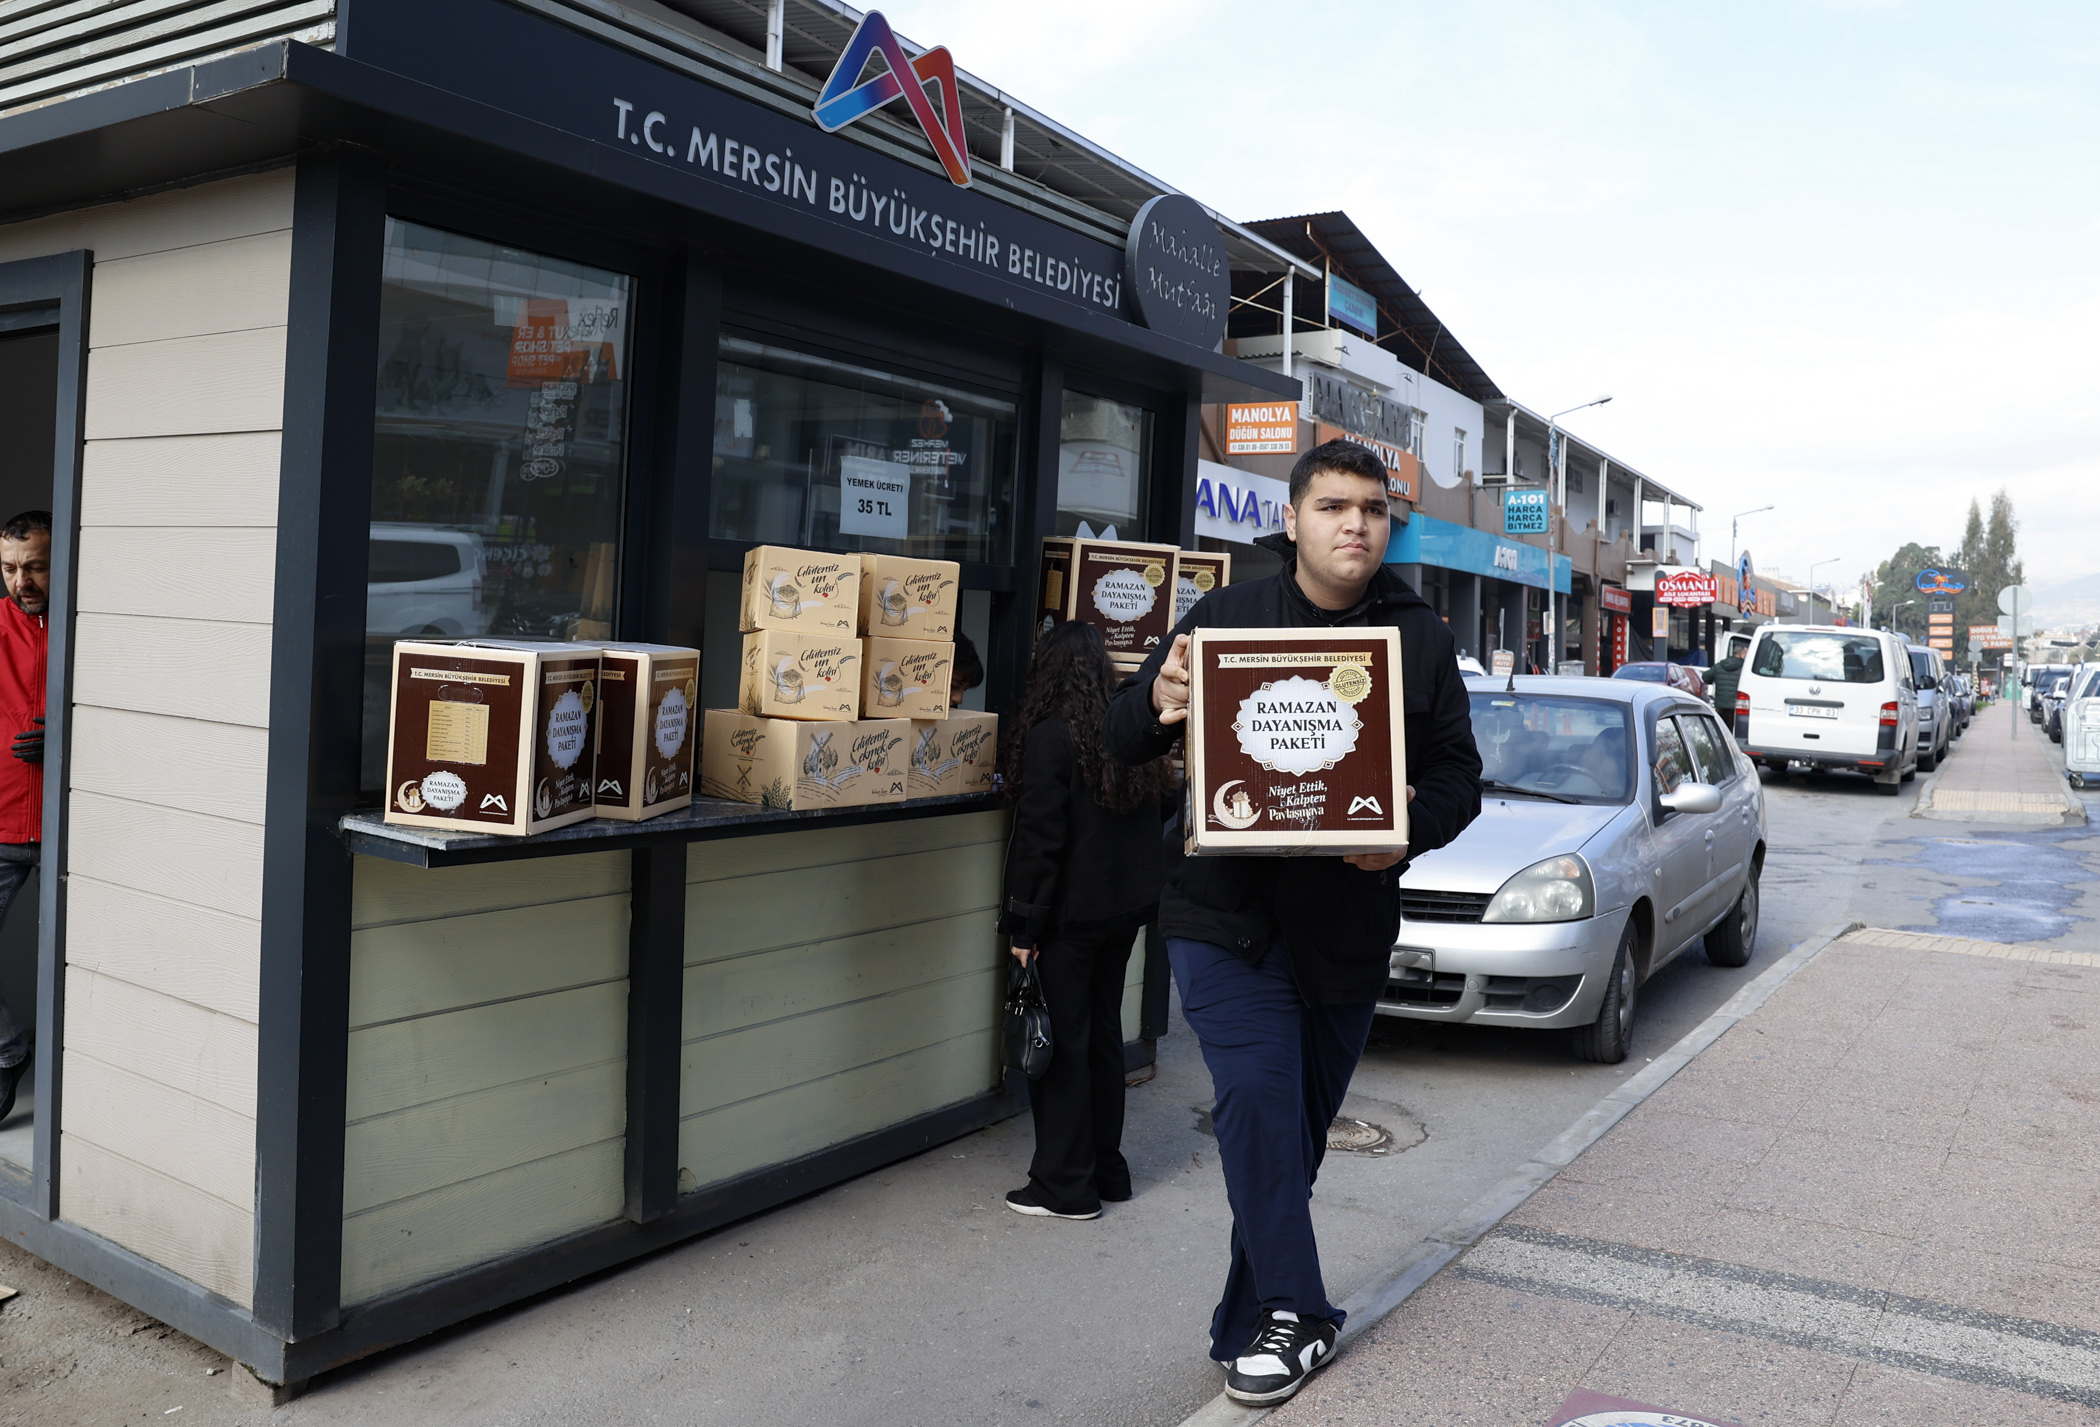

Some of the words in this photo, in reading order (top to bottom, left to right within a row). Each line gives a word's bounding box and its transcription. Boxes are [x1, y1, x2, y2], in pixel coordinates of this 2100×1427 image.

[613, 97, 676, 157] T.C.
[686, 126, 817, 205] MERSİN
[828, 172, 1000, 268] BÜYÜKŞEHİR
[1008, 242, 1122, 310] BELEDİYESİ
[1149, 220, 1222, 278] Mahalle
[1231, 407, 1292, 423] MANOLYA
[1229, 425, 1259, 440] DÜĞÜN
[1260, 427, 1293, 440] SALONU
[846, 477, 875, 489] YEMEK
[876, 479, 904, 493] ÜCRETİ
[857, 499, 873, 514] 35
[877, 501, 892, 516] TL
[1508, 505, 1543, 513] HARCA
[1508, 513, 1543, 522] HARCA
[811, 575, 827, 584] un
[1658, 580, 1715, 591] OSMANLI
[916, 584, 931, 592] un
[1105, 581, 1146, 591] RAMAZAN
[1101, 591, 1147, 603] DAYANIŞMA
[1109, 600, 1138, 610] PAKETİ
[814, 659, 829, 667] un
[1239, 655, 1269, 663] MERSİN
[1271, 654, 1322, 664] BÜYÜKŞEHİR
[1324, 654, 1366, 662] BELEDİYESİ
[912, 663, 926, 672] un
[424, 671, 444, 679] MERSİN
[444, 672, 477, 681] BÜYÜKŞEHİR
[478, 676, 506, 684] BELEDİYESİ
[662, 704, 683, 716] RAMAZAN
[1256, 701, 1337, 714] RAMAZAN
[1794, 706, 1803, 714] 33
[1826, 708, 1836, 716] 03
[555, 710, 581, 723] RAMAZAN
[659, 718, 684, 732] DAYANIŞMA
[1252, 719, 1343, 736] DAYANIŞMA
[552, 725, 582, 739] DAYANIŞMA
[663, 731, 679, 742] PAKETİ
[557, 737, 576, 752] PAKETİ
[1270, 733, 1326, 750] PAKETİ
[429, 780, 459, 788] RAMAZAN
[426, 787, 461, 797] DAYANIŞMA
[1268, 785, 1297, 798] Niyet
[433, 794, 454, 802] PAKETİ
[1286, 794, 1326, 807] Kalpten
